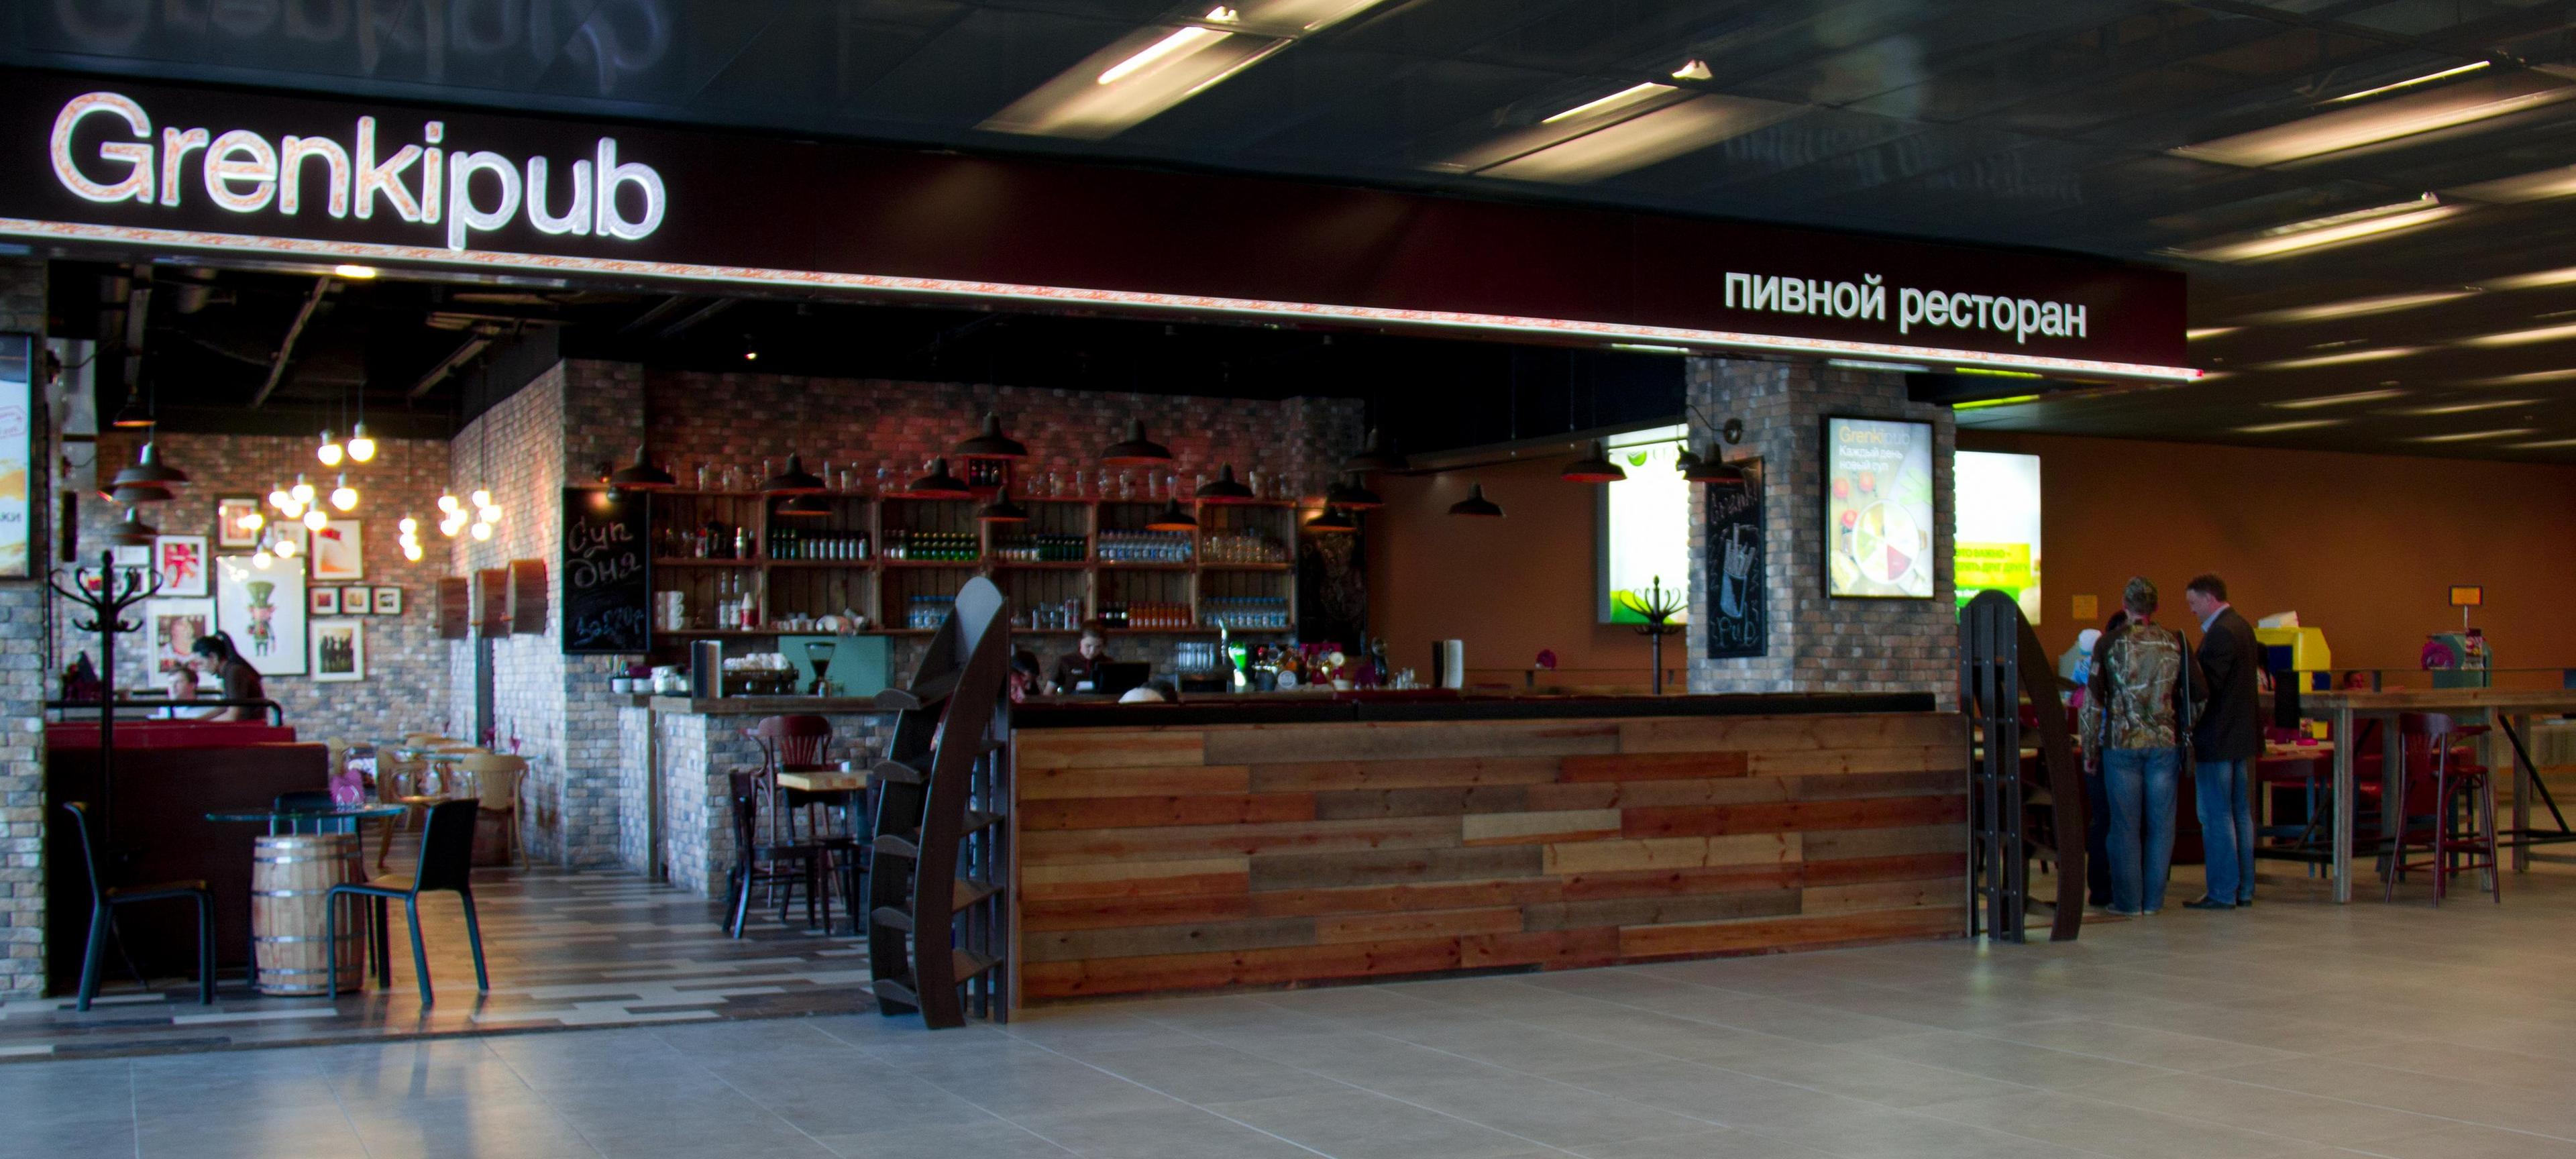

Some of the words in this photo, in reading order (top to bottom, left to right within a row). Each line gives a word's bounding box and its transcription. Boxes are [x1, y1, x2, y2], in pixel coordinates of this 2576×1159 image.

[50, 91, 667, 251] Grenkipub
[1725, 272, 1885, 321] пивной
[1899, 286, 2087, 343] ресторан
[568, 515, 634, 558] Суп
[566, 552, 643, 588] дня
